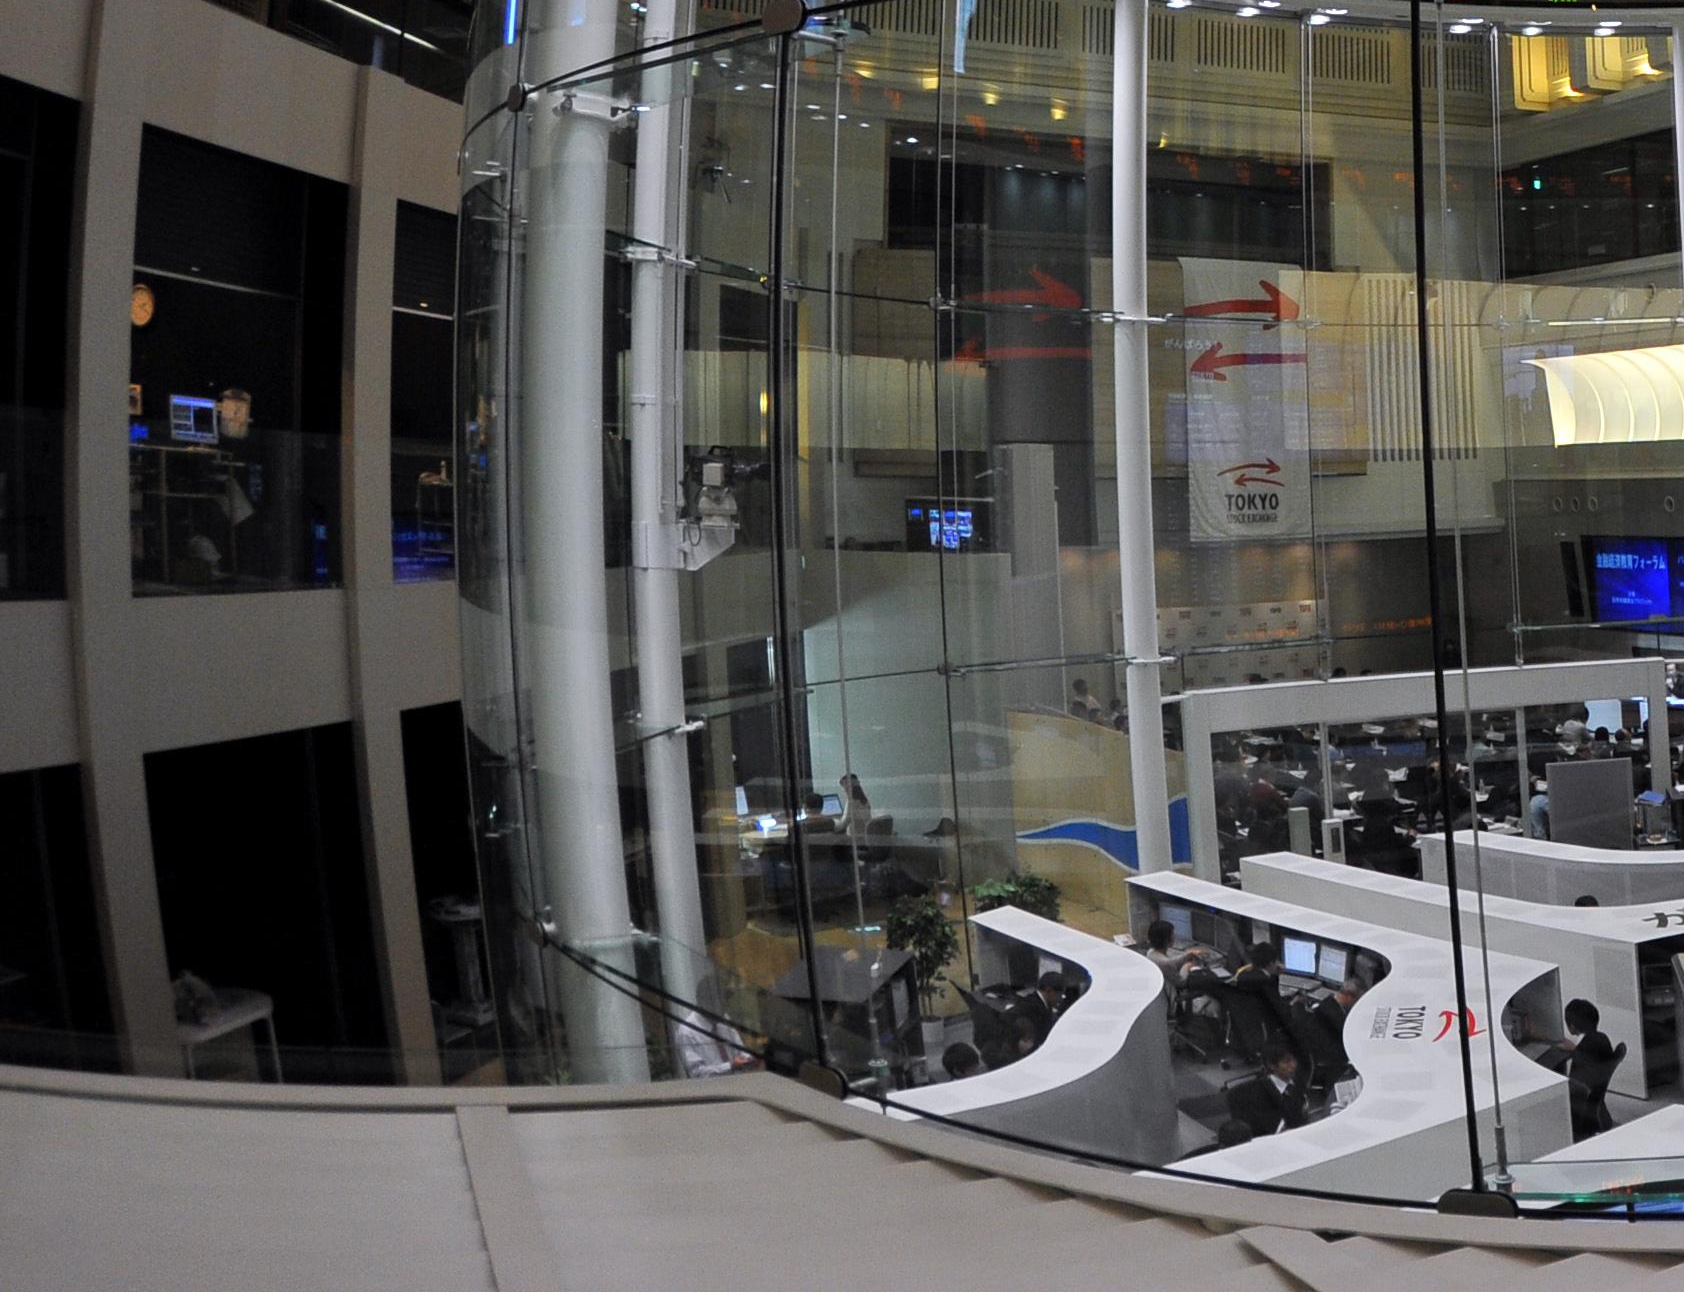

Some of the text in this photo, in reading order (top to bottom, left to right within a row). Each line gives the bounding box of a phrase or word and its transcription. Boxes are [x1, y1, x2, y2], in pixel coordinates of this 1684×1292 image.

[1224, 492, 1280, 512] TOKYO
[1596, 552, 1667, 570] 金融経済教育フォーラム
[1392, 1005, 1426, 1040] TOKYO
